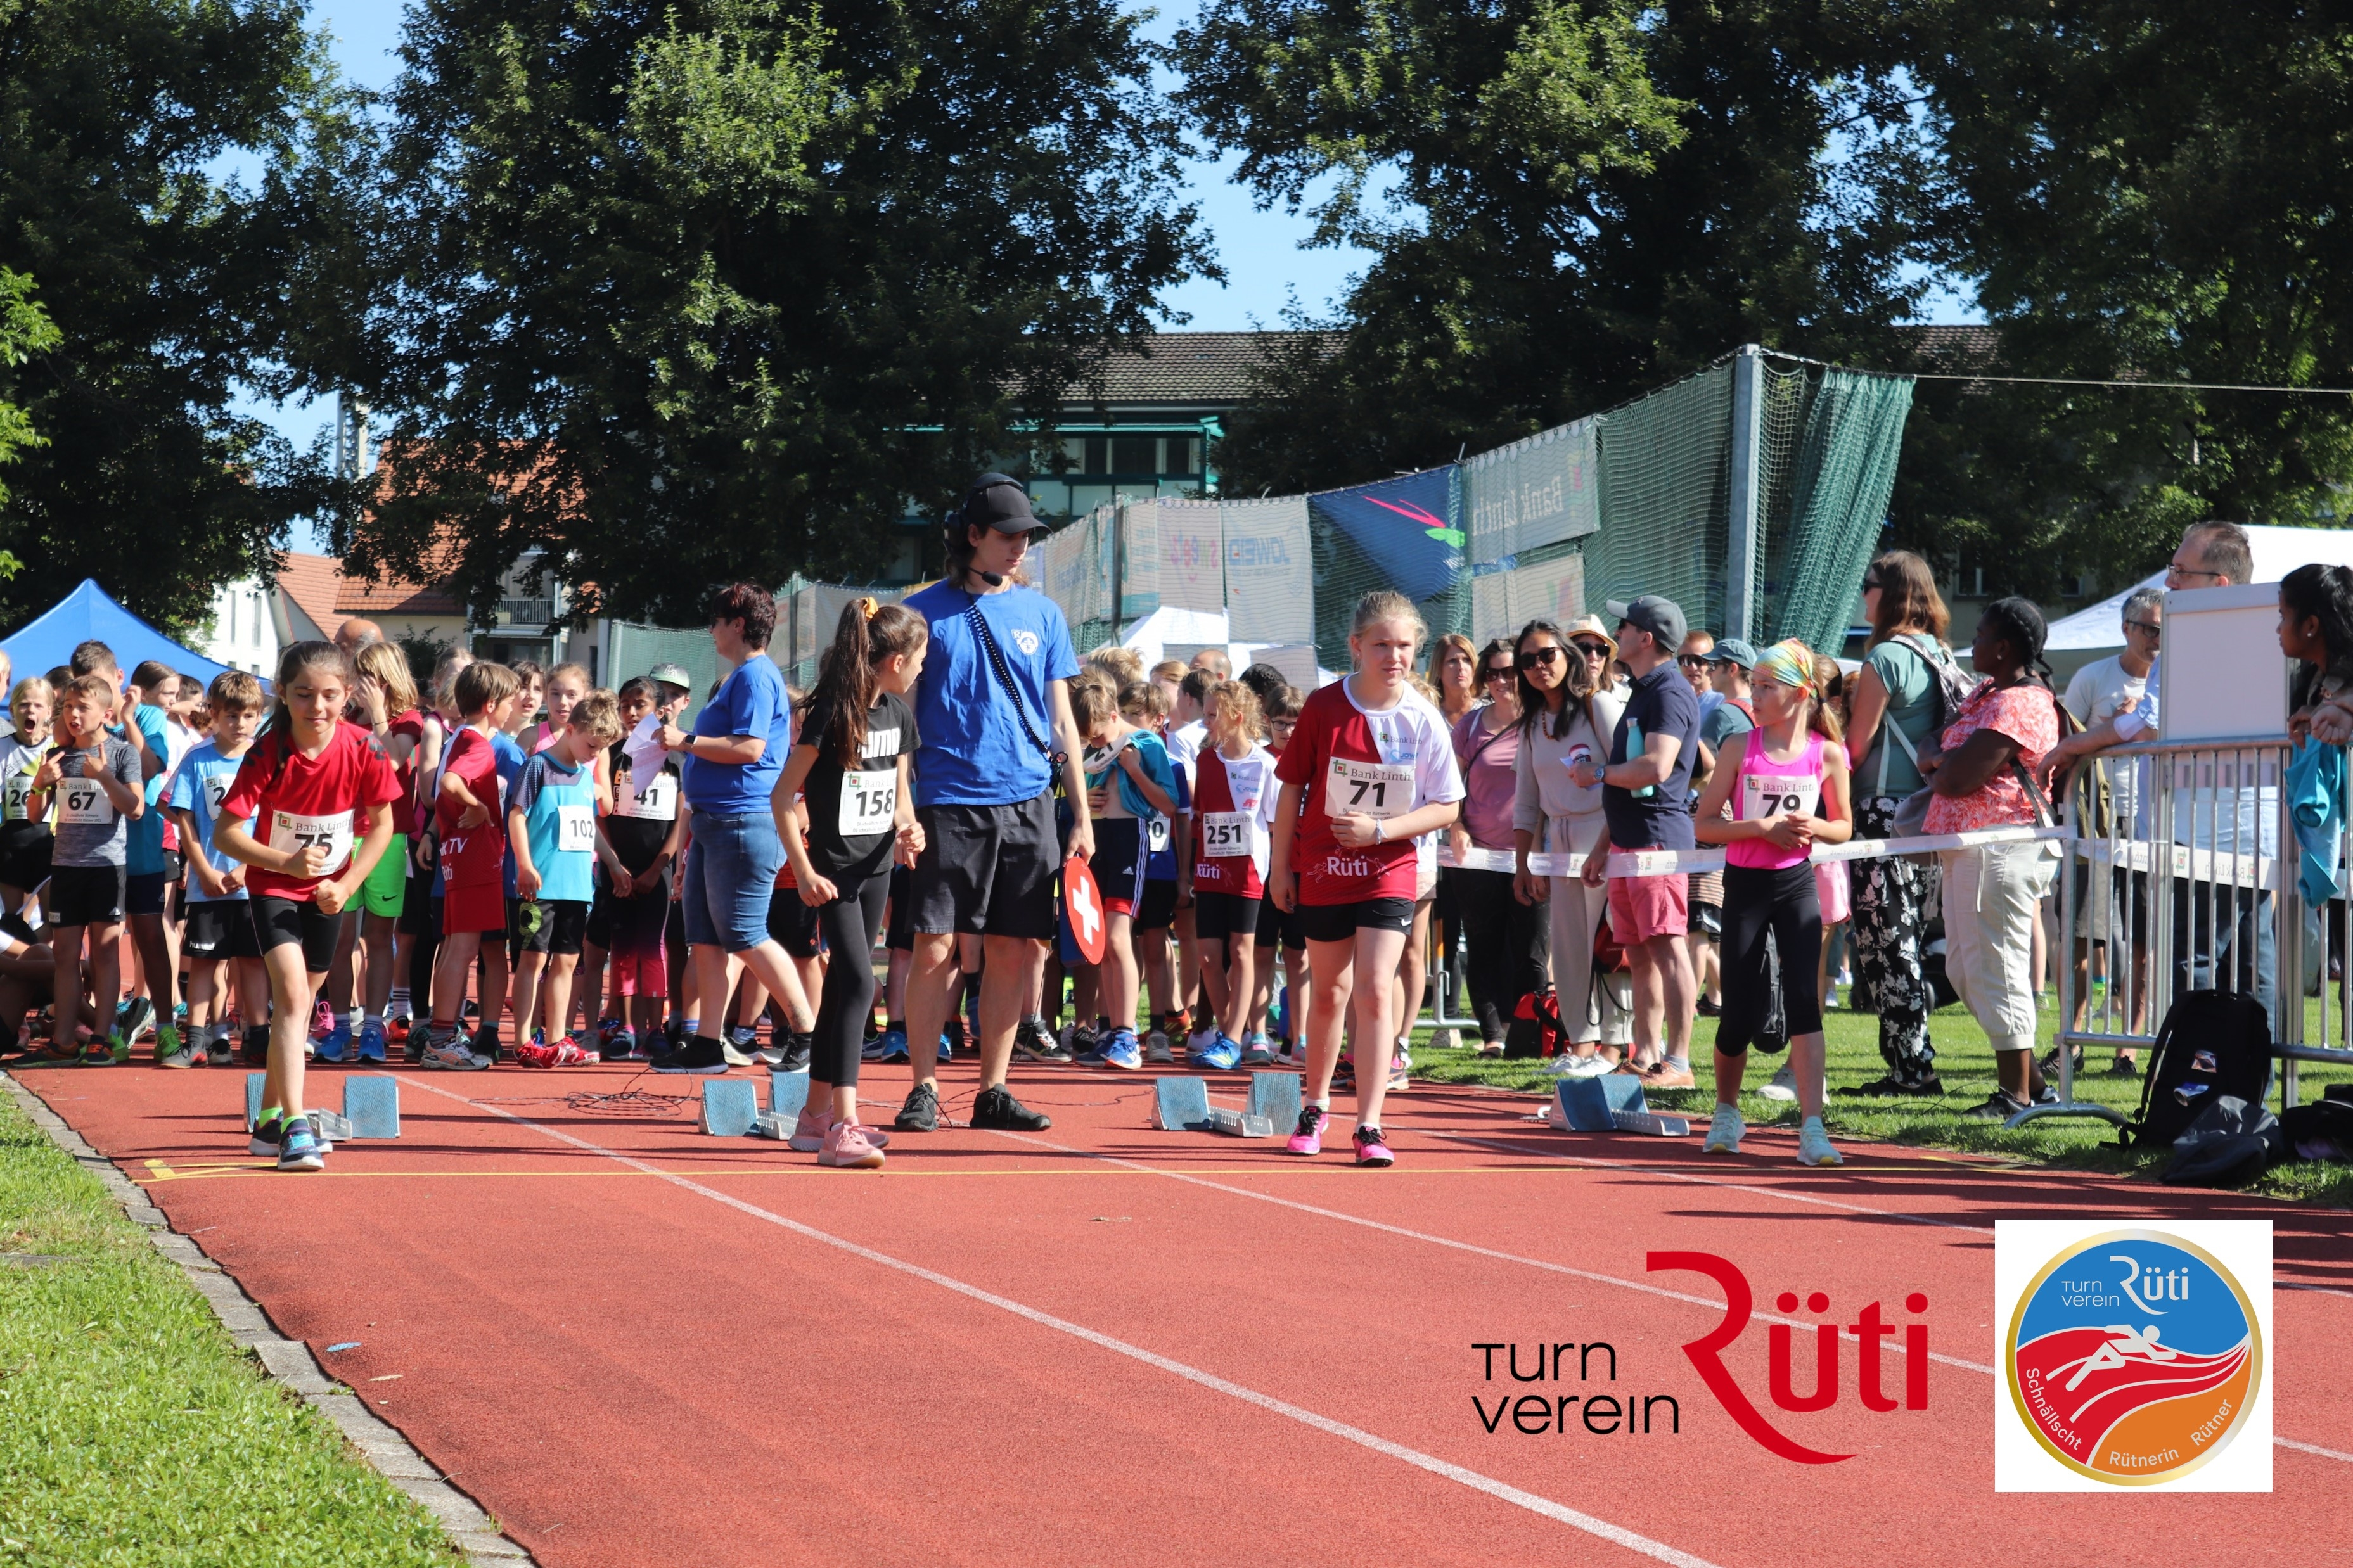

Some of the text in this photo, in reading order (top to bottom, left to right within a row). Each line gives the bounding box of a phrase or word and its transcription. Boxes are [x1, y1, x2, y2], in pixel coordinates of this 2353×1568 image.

[864, 779, 885, 788] Bank
[1350, 768, 1411, 781] Bank Linth
[1349, 779, 1386, 807] 71
[1763, 782, 1790, 792] Bank
[68, 791, 97, 811] 67
[633, 788, 658, 807] 41
[856, 788, 894, 817] 158
[1762, 794, 1801, 819] 79
[295, 818, 352, 832] Bank Linth
[570, 819, 593, 839] 102
[1146, 821, 1164, 839] 0
[1229, 816, 1251, 824] Linth
[1207, 824, 1241, 845] 251
[295, 833, 333, 858] 75
[1326, 855, 1368, 877] Rüti
